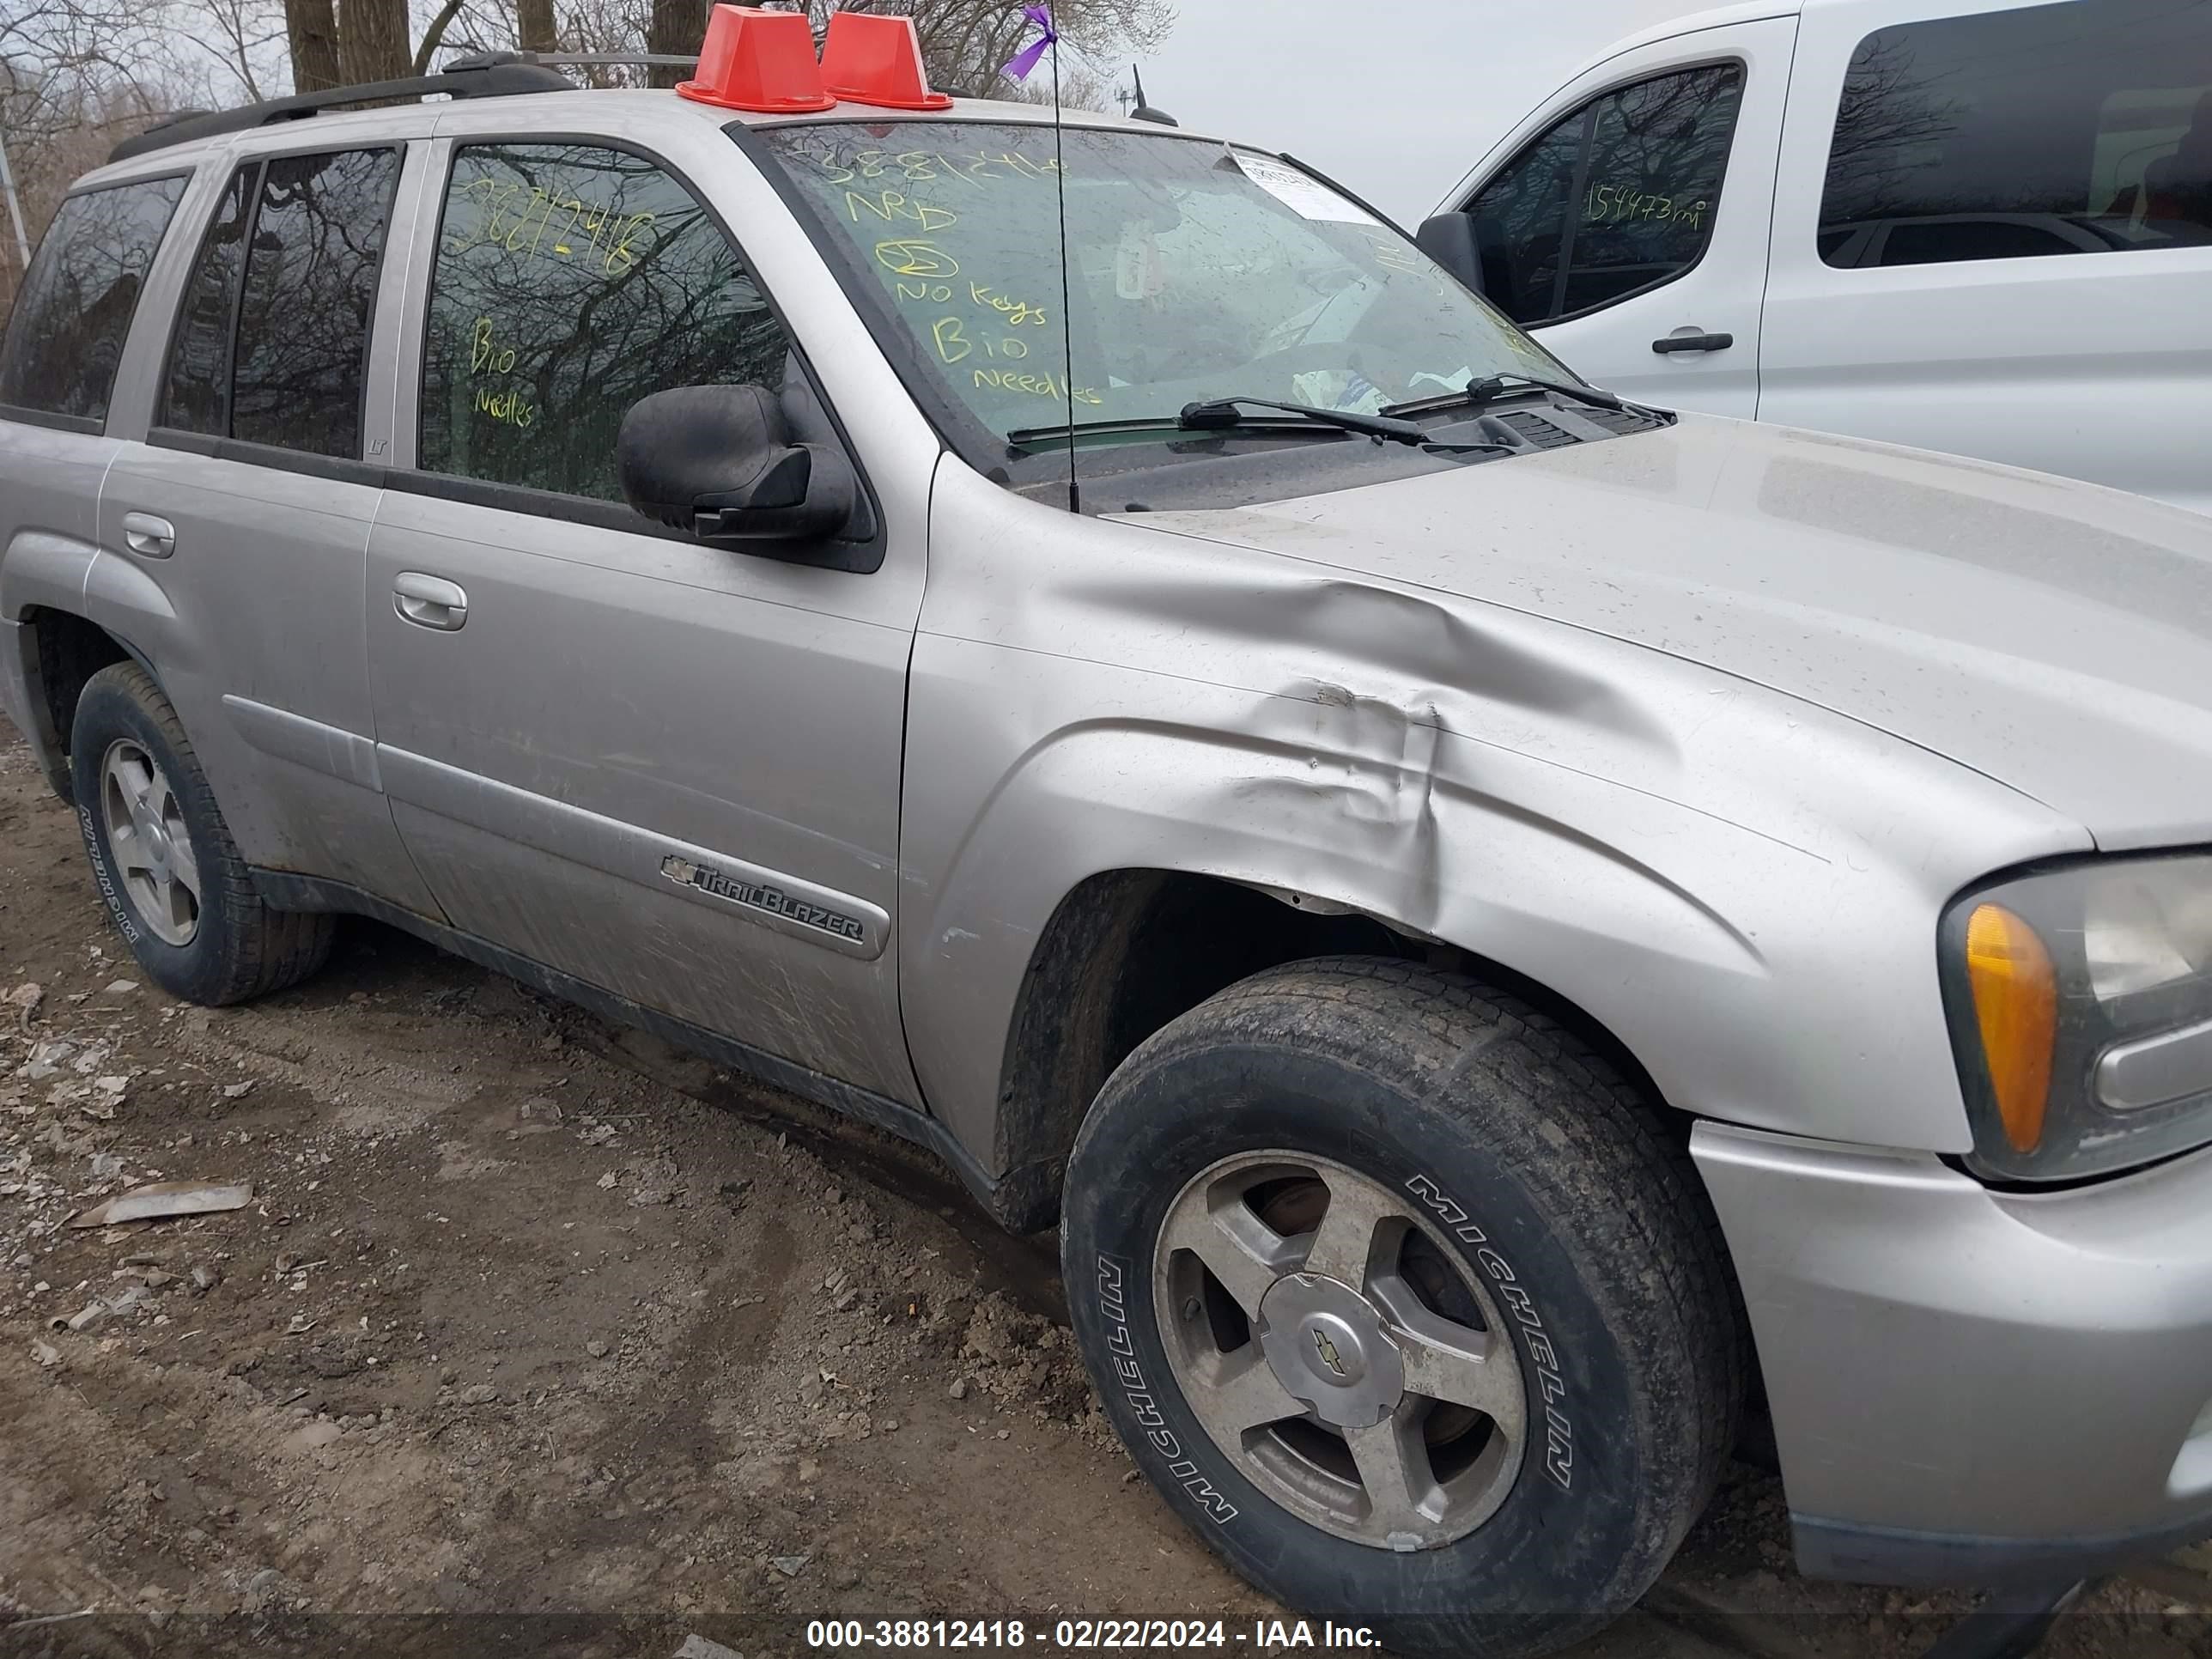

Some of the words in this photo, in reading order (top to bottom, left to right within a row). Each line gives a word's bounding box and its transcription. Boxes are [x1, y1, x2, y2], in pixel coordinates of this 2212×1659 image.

[368, 439, 388, 455] LT
[80, 804, 140, 944] MICHELIN
[1097, 1255, 1239, 1526] MICHELIN
[1406, 1173, 1573, 1490] MICHELIN
